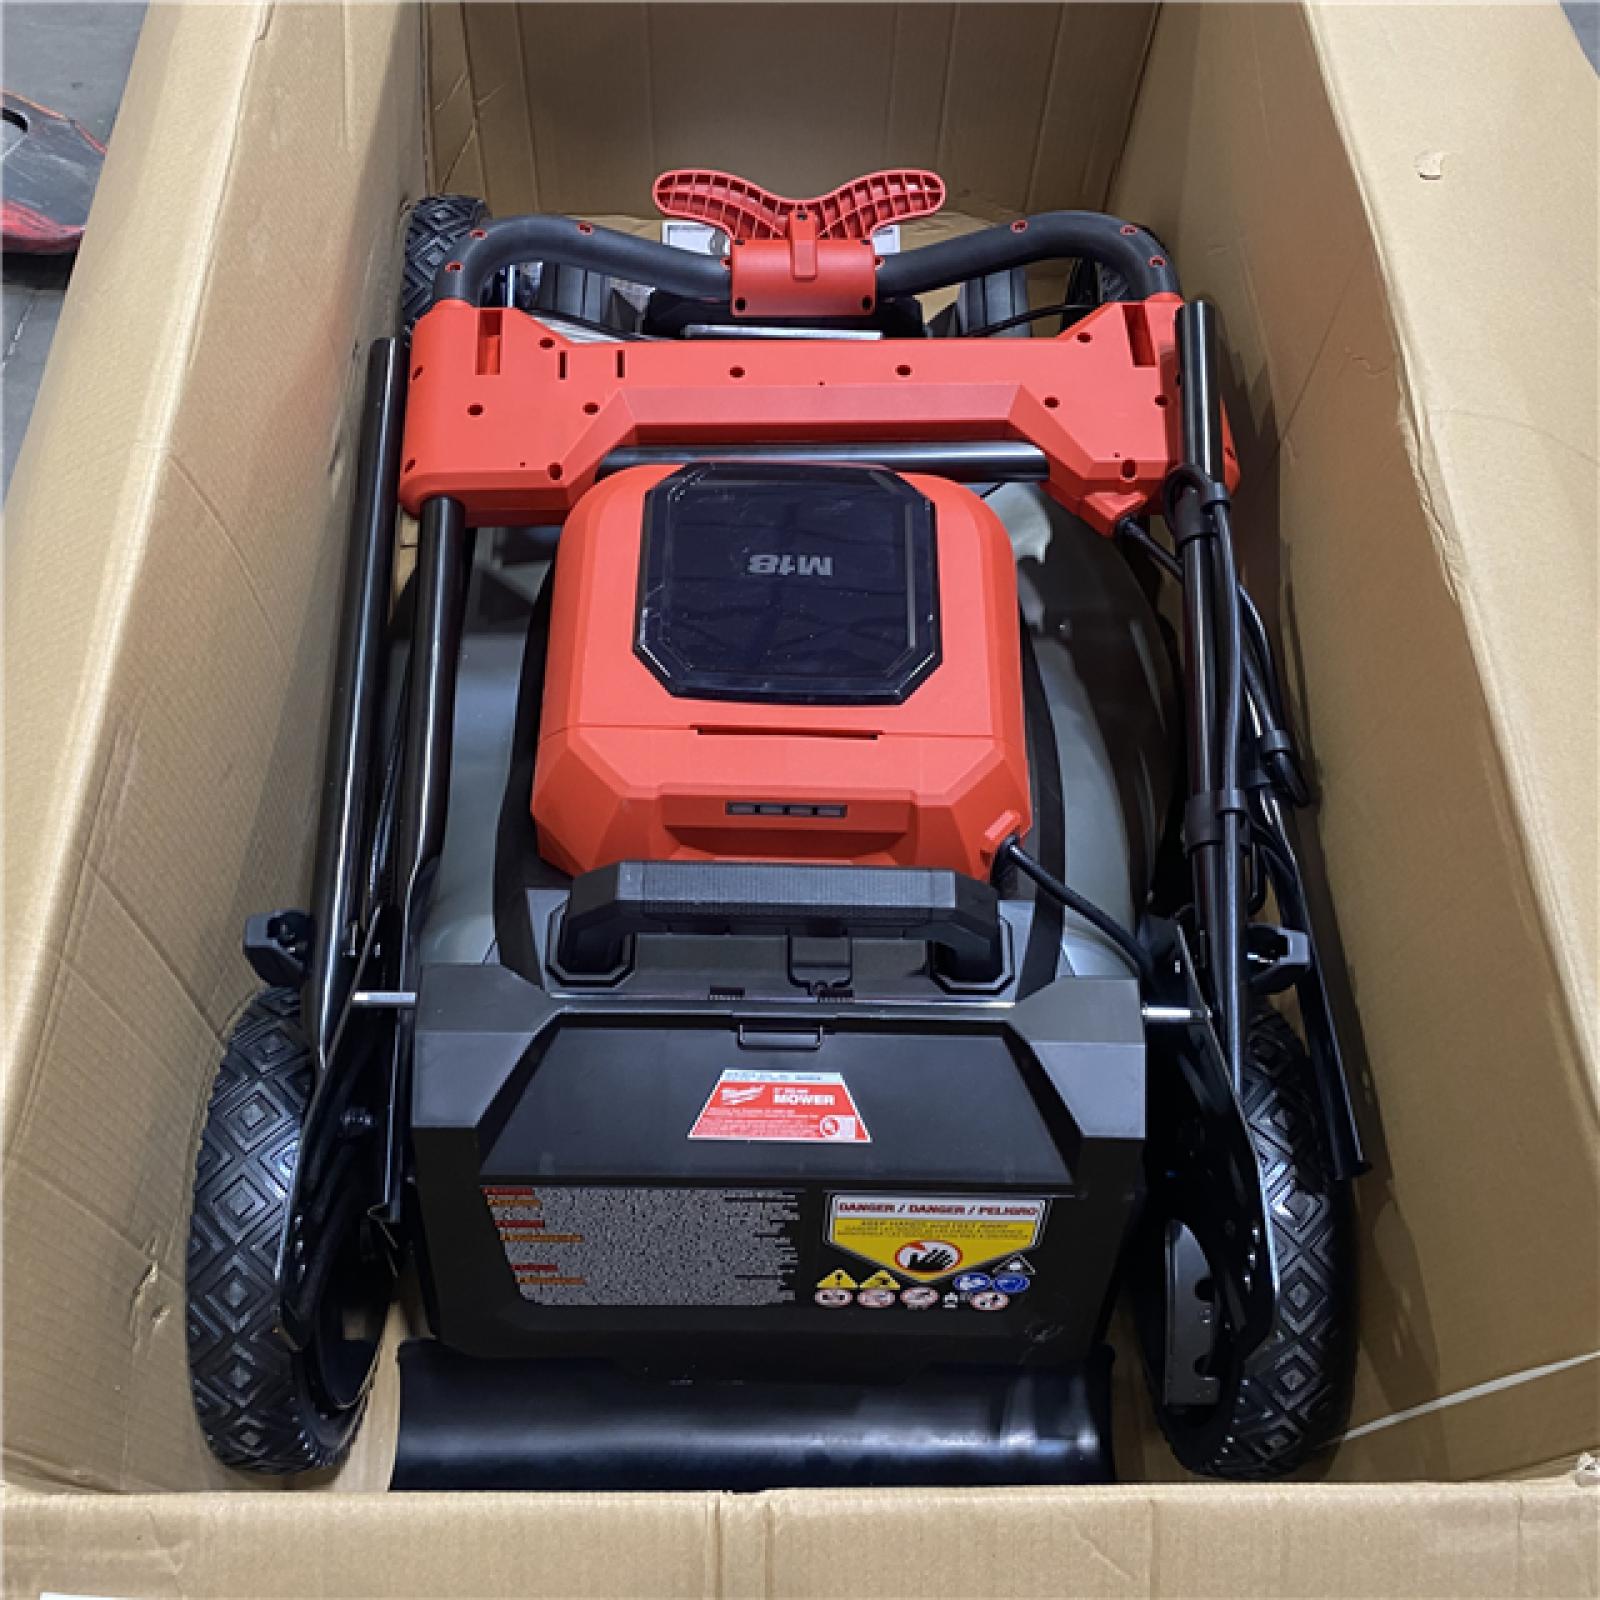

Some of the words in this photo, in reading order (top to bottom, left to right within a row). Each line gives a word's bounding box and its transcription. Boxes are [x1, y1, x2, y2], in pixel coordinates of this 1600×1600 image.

[748, 554, 832, 576] M18
[773, 1094, 835, 1106] MOWER
[839, 1202, 896, 1213] DANGER
[909, 1204, 966, 1215] DANGER
[979, 1206, 1038, 1217] PELIGRO
